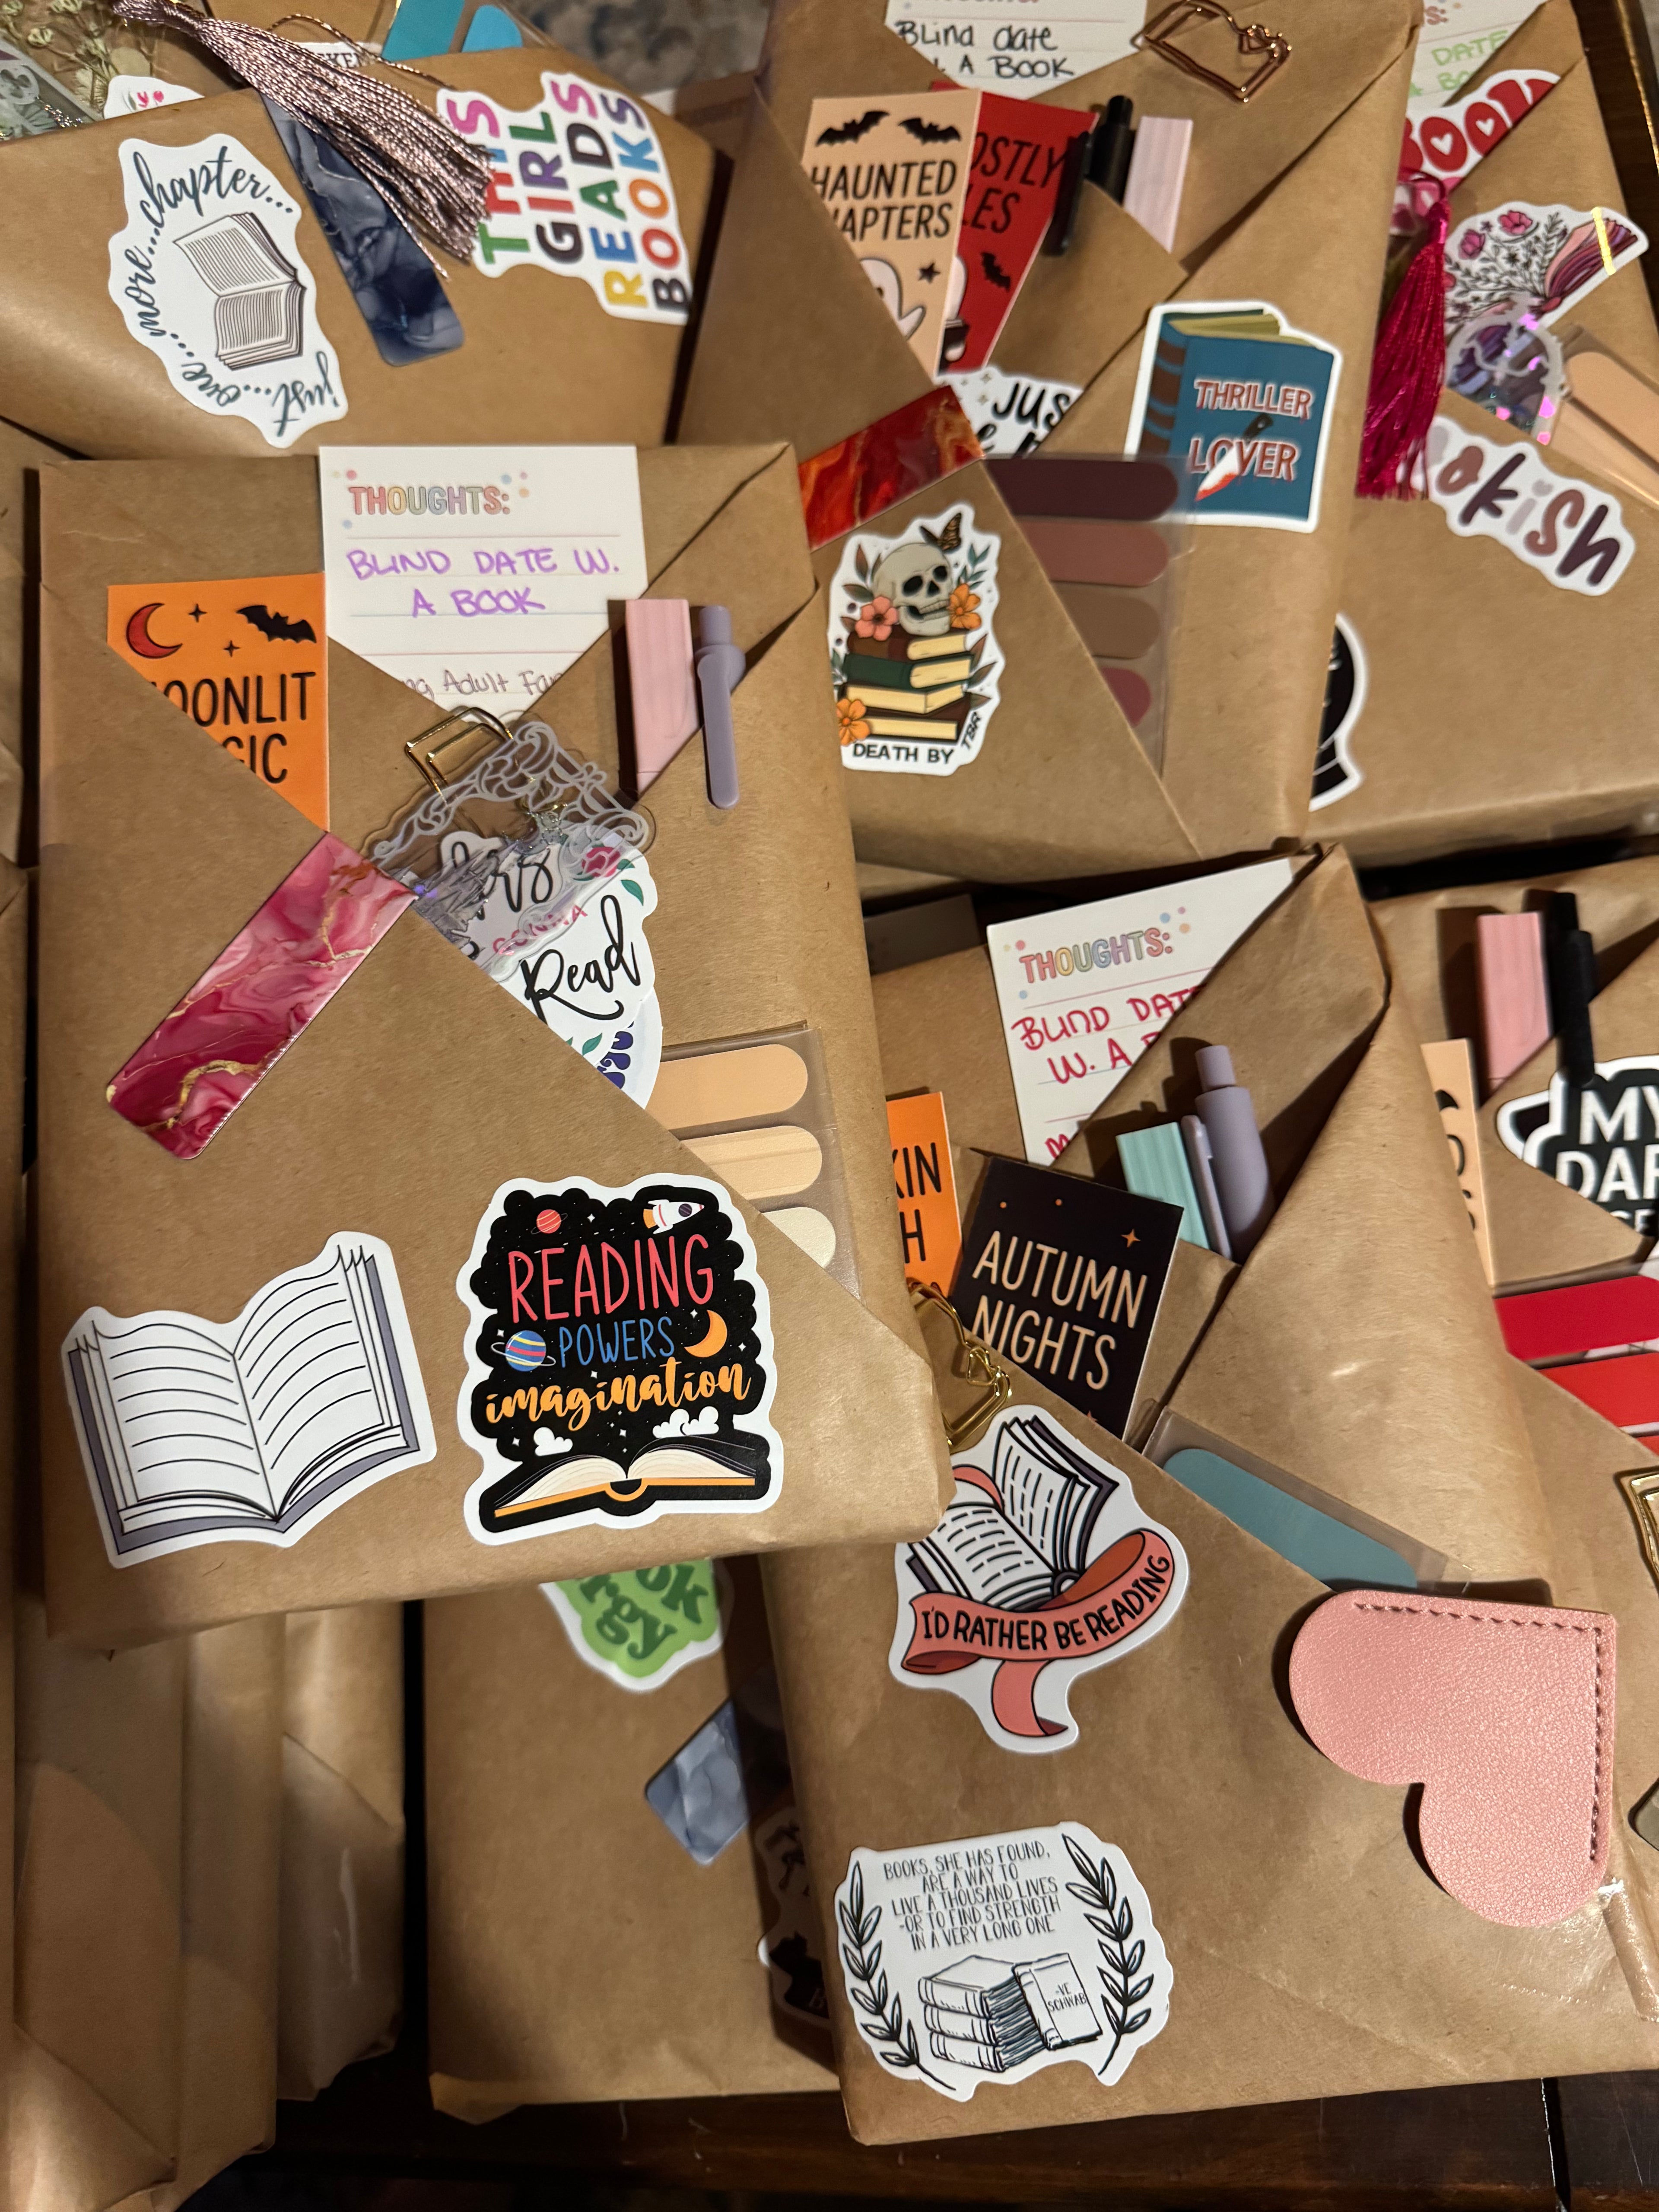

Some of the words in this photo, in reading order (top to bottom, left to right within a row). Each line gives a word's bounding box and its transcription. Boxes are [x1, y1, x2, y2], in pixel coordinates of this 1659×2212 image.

[959, 54, 974, 74] A
[988, 55, 1074, 79] BOOK
[509, 111, 583, 264] GIRL
[550, 80, 648, 307] READS
[811, 159, 957, 201] HAUNTED
[599, 92, 691, 313] BOOKS
[833, 202, 953, 242] APTERS
[1194, 379, 1313, 420] THRILLER
[1187, 437, 1299, 481] LOVER
[348, 486, 510, 515] THOUGHTS:
[346, 549, 451, 580] BLIND
[474, 548, 557, 575] DATE
[411, 588, 436, 618] A
[451, 587, 546, 617] BOOK
[151, 671, 316, 727] OONLIT
[444, 670, 508, 695] Adult
[852, 743, 918, 762] DEATH
[927, 749, 954, 764] BY
[960, 712, 981, 750] TBR
[519, 894, 642, 1023] Read
[1019, 928, 1173, 984] THOUGHTS:
[1126, 983, 1206, 1022] DAT
[1108, 1038, 1132, 1070] A
[508, 1234, 715, 1324] READING
[972, 1230, 1147, 1329] AUTUMN
[558, 1316, 676, 1369] POWERS
[972, 1295, 1116, 1390] NIGHTS
[485, 1356, 752, 1431] imagination
[921, 1606, 949, 1639] I'D
[953, 1610, 1048, 1650] RATHER
[1053, 1619, 1088, 1650] BE
[1084, 1555, 1170, 1642] READING
[883, 1858, 933, 1880] BOOKS,
[935, 1852, 963, 1872] SHE
[966, 1848, 993, 1868] HAS
[997, 1840, 1050, 1863] FOUND,
[923, 1873, 949, 1893] ARE
[953, 1871, 962, 1889] A
[964, 1866, 994, 1886] WAY
[999, 1862, 1018, 1881] TO
[892, 1895, 923, 1916] LIVE
[928, 1894, 936, 1911] A
[939, 1883, 1012, 1909] THOUSAND
[1016, 1876, 1058, 1898] LIVES
[927, 1911, 945, 1930] TO
[949, 1907, 981, 1926] FIND
[985, 1894, 1061, 1921] STRENGTH
[911, 1932, 926, 1951] IN
[931, 1930, 940, 1948] A
[943, 1925, 978, 1947] VERY
[983, 1920, 1022, 1941] LONG
[1026, 1914, 1055, 1934] ONE
[1048, 1993, 1086, 2012] SCHWAB
